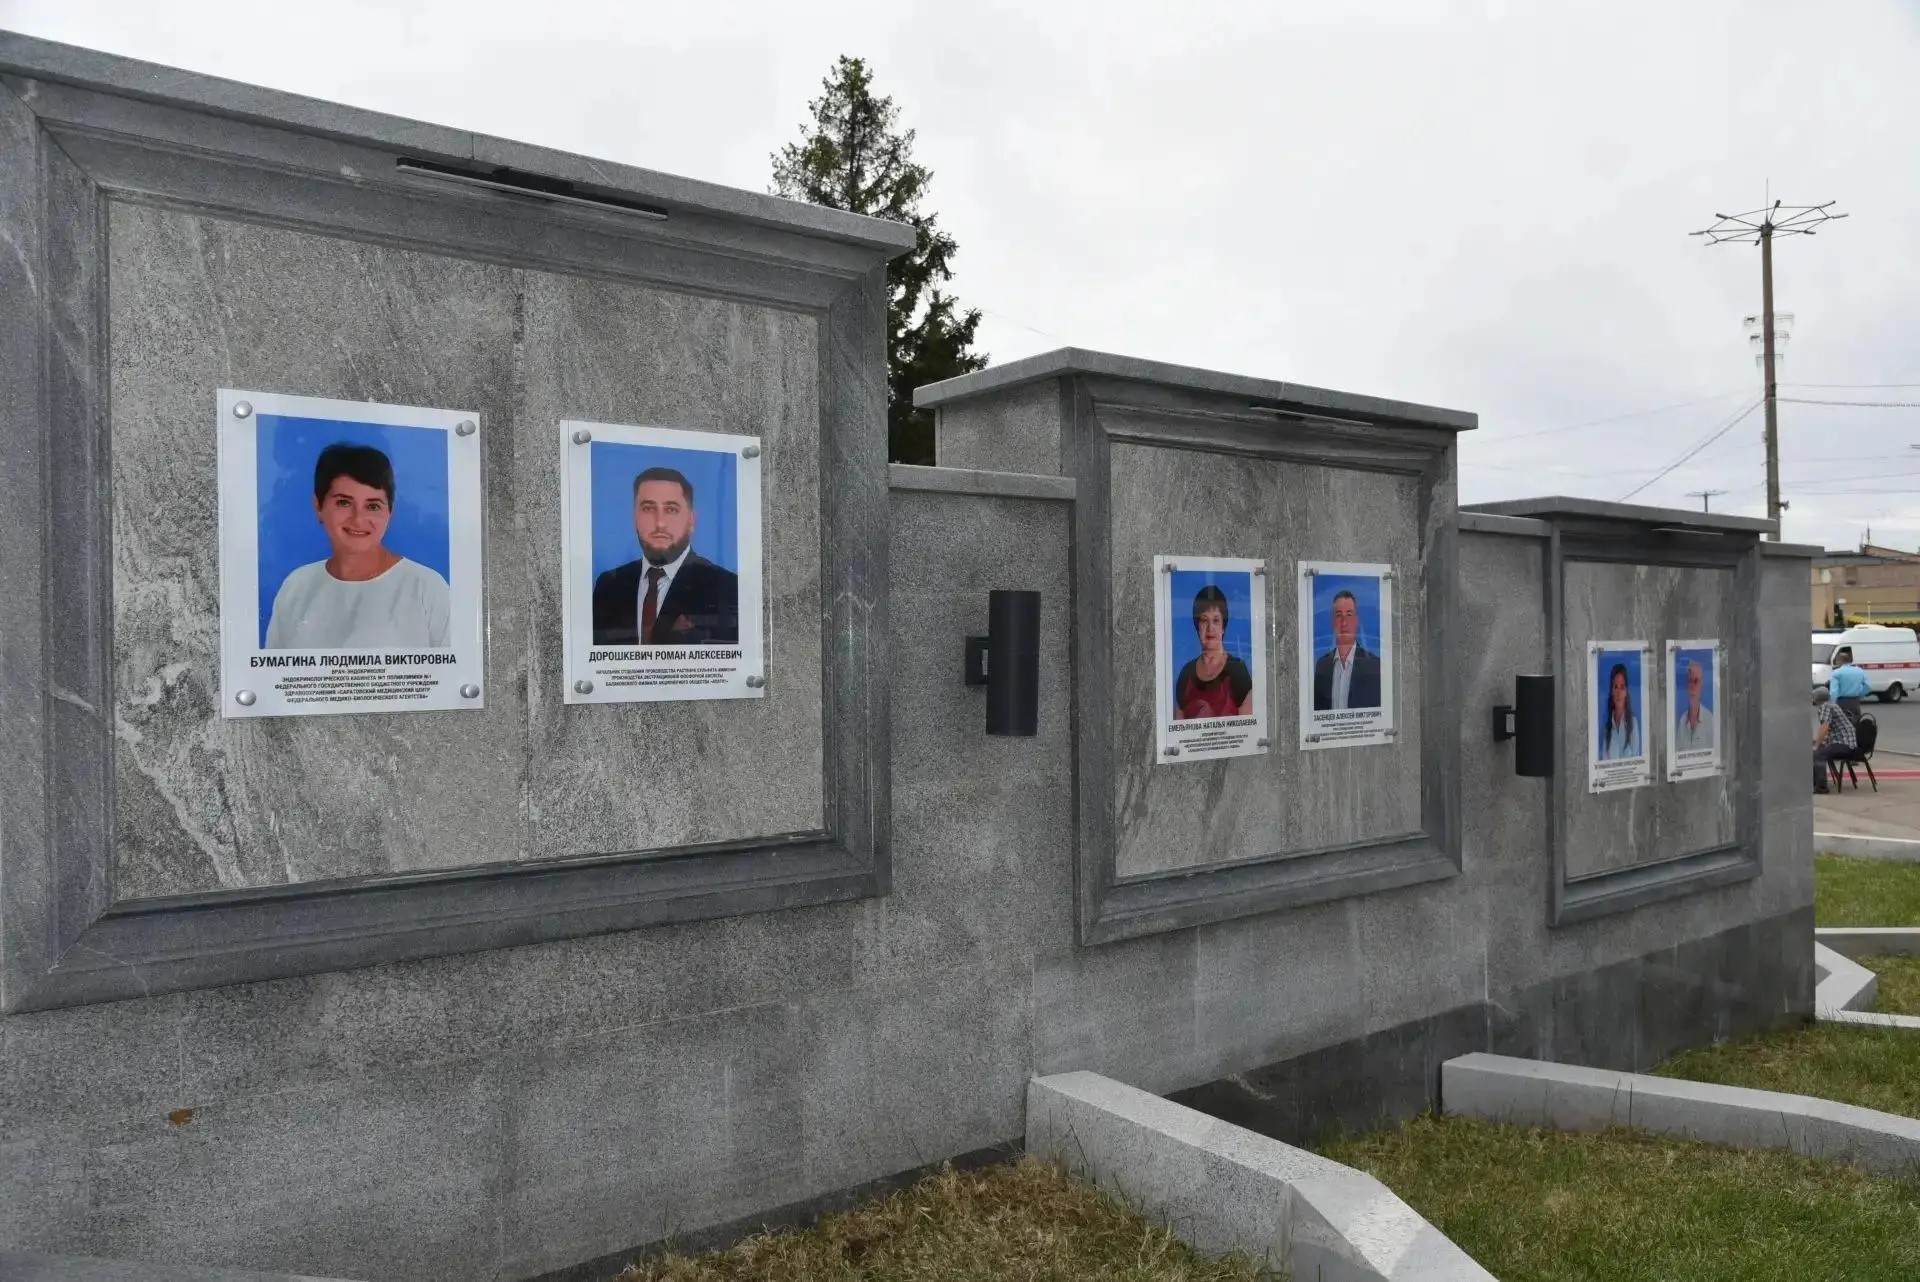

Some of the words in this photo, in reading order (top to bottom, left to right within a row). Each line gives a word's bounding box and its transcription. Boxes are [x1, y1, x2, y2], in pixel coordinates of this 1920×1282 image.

[250, 656, 316, 667] БУМАГИНА
[319, 655, 382, 667] ЛЮДМИЛА
[385, 654, 456, 665] ВИКТОРОВНА
[589, 651, 653, 662] ДОРОШКЕВИЧ
[655, 650, 686, 660] РОМАН
[688, 650, 742, 660] АЛЕКСЕЕВИЧ
[1202, 721, 1226, 730] НАТАЛЬЯ
